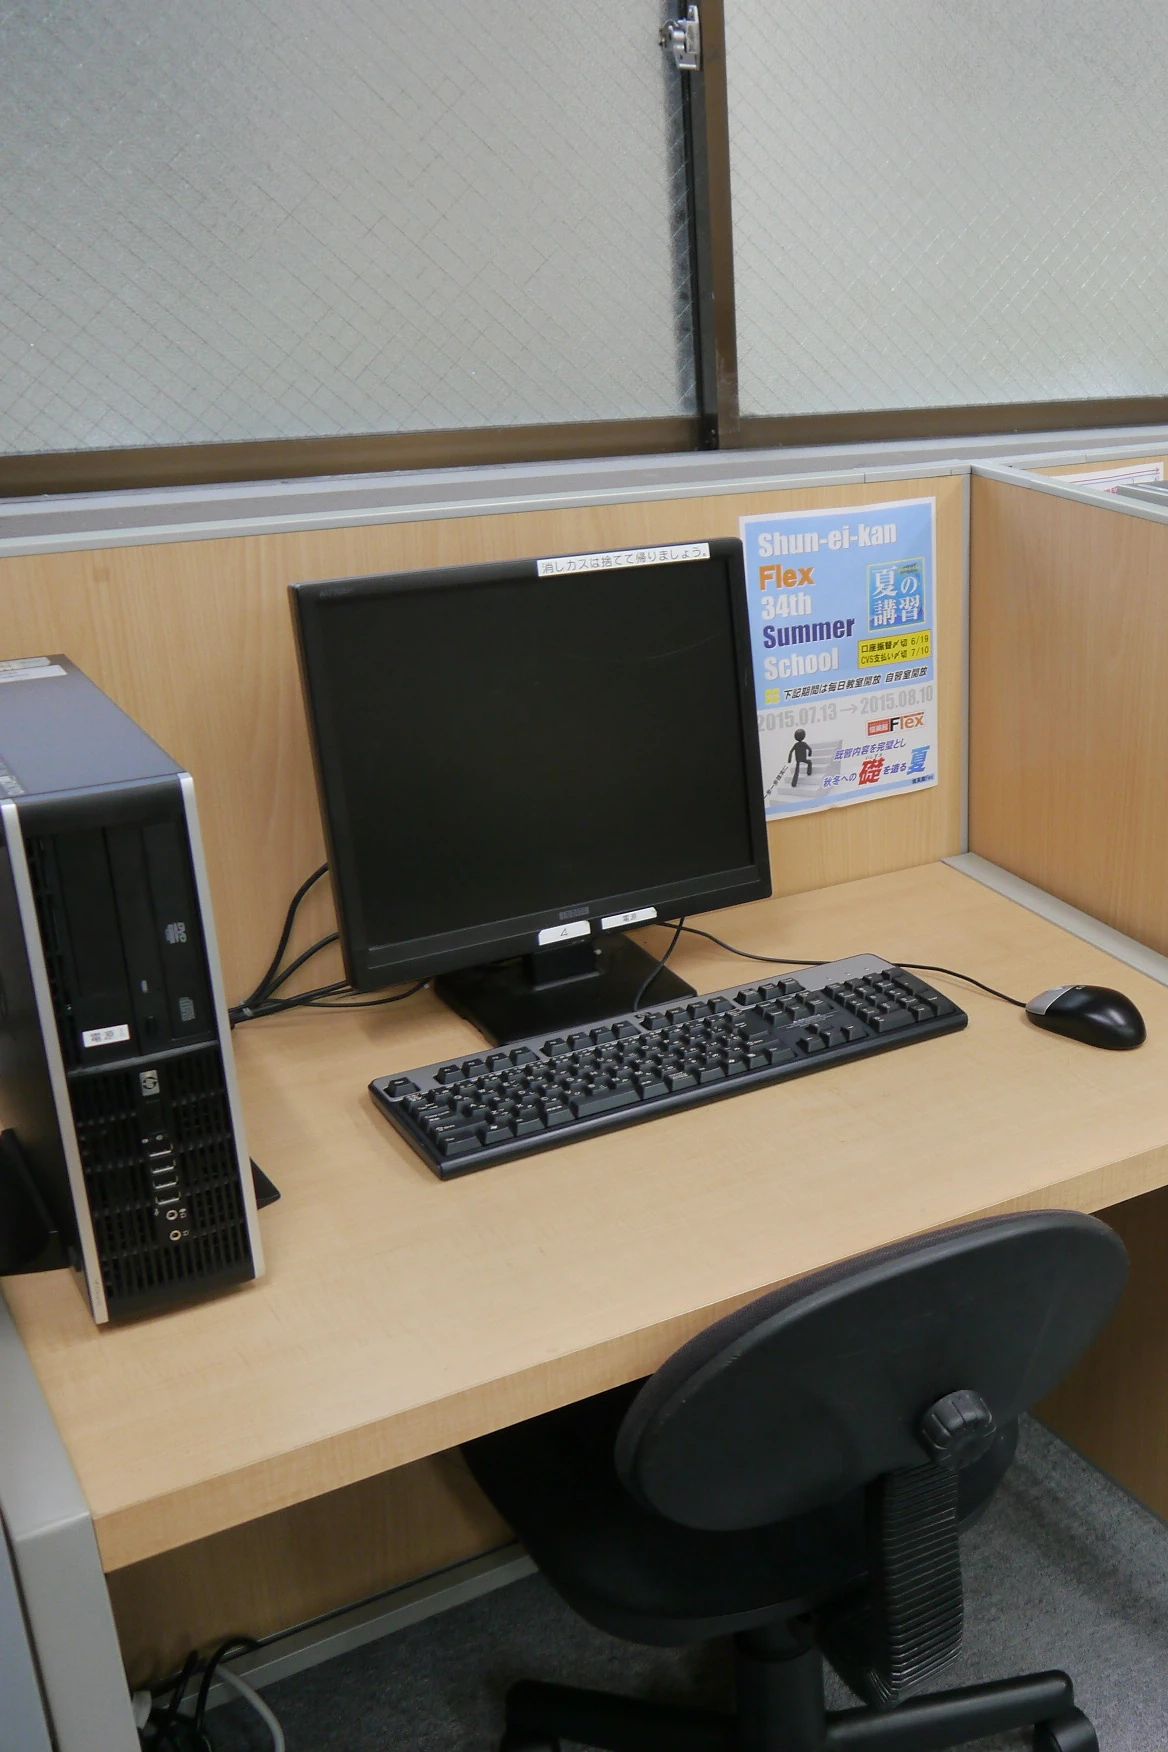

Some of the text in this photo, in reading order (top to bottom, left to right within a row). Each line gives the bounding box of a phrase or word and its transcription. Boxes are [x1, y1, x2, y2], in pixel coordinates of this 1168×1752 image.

[758, 523, 897, 558] Shun-ei-kan
[759, 564, 816, 592] Flex
[762, 592, 812, 620] 34th
[763, 618, 855, 649] Summer
[764, 647, 839, 681] School
